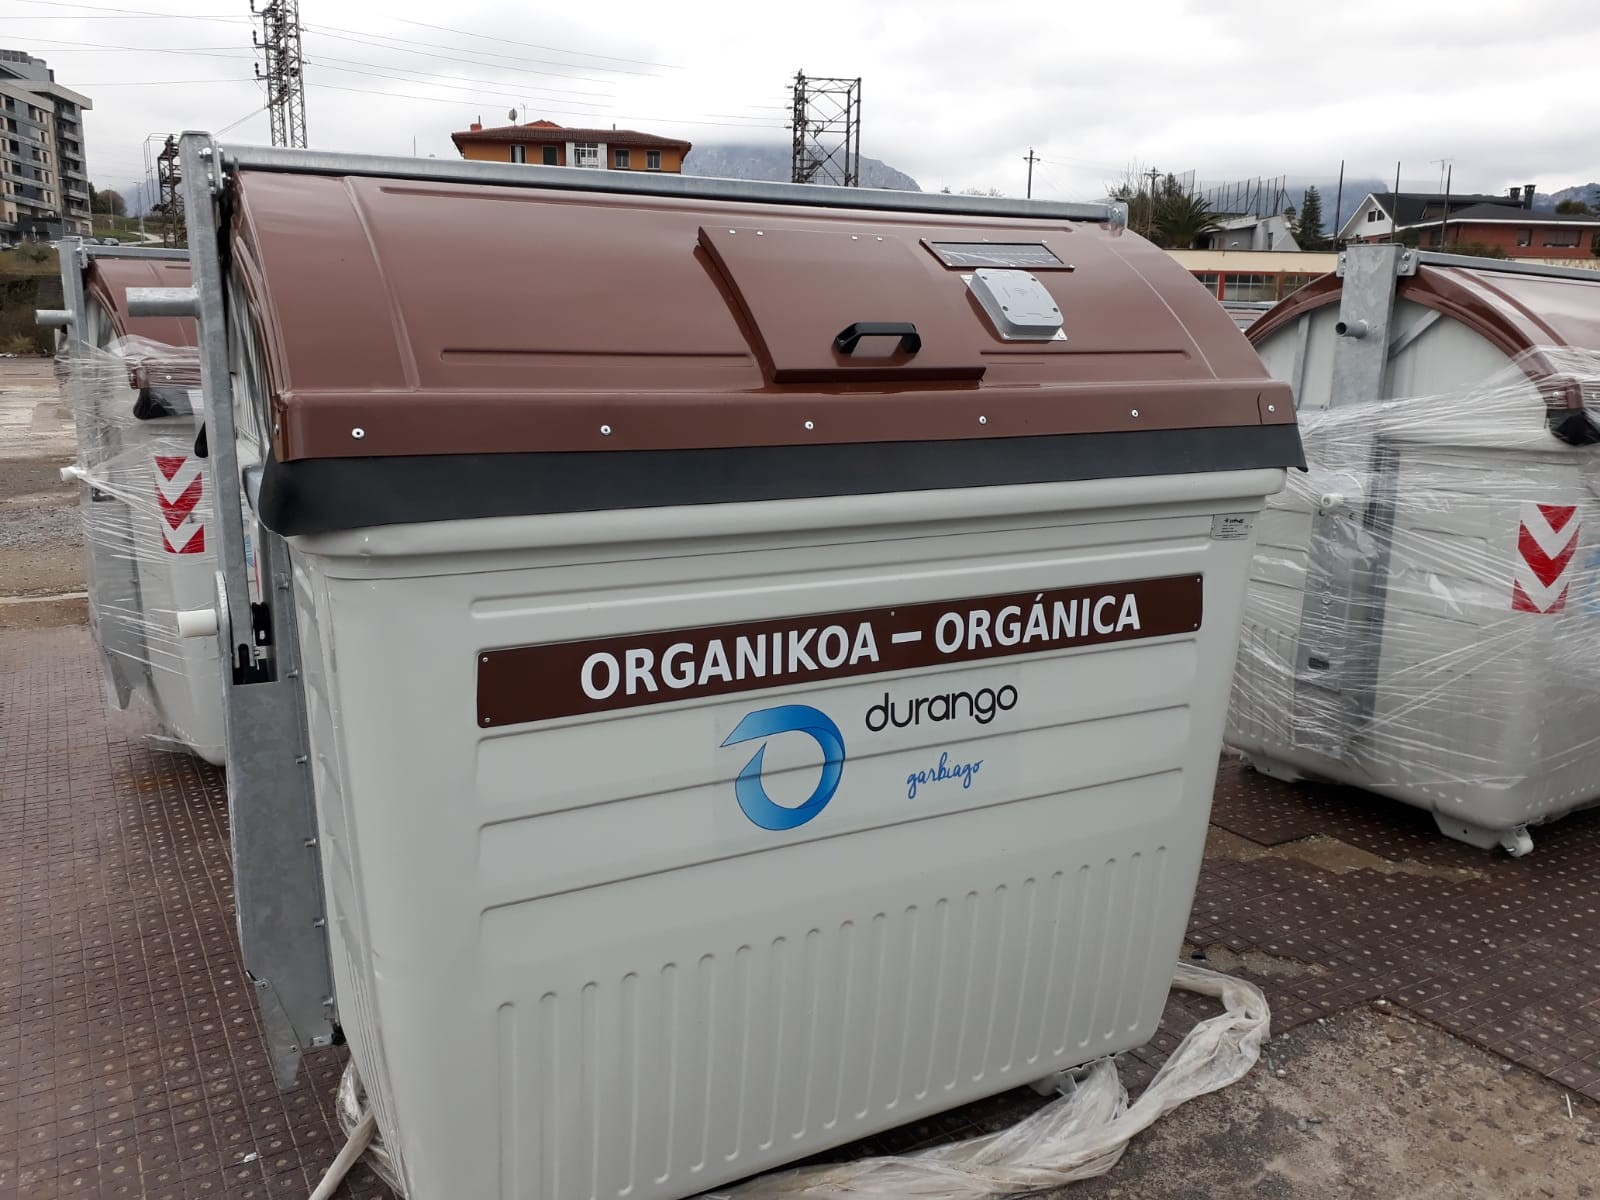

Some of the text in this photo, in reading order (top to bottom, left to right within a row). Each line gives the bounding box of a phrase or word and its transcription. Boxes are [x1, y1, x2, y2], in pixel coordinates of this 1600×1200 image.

[580, 622, 880, 700] ORGANIKOA
[935, 593, 1141, 654] ORGÁNICA
[864, 683, 1018, 733] durango
[906, 751, 983, 800] garbiago
